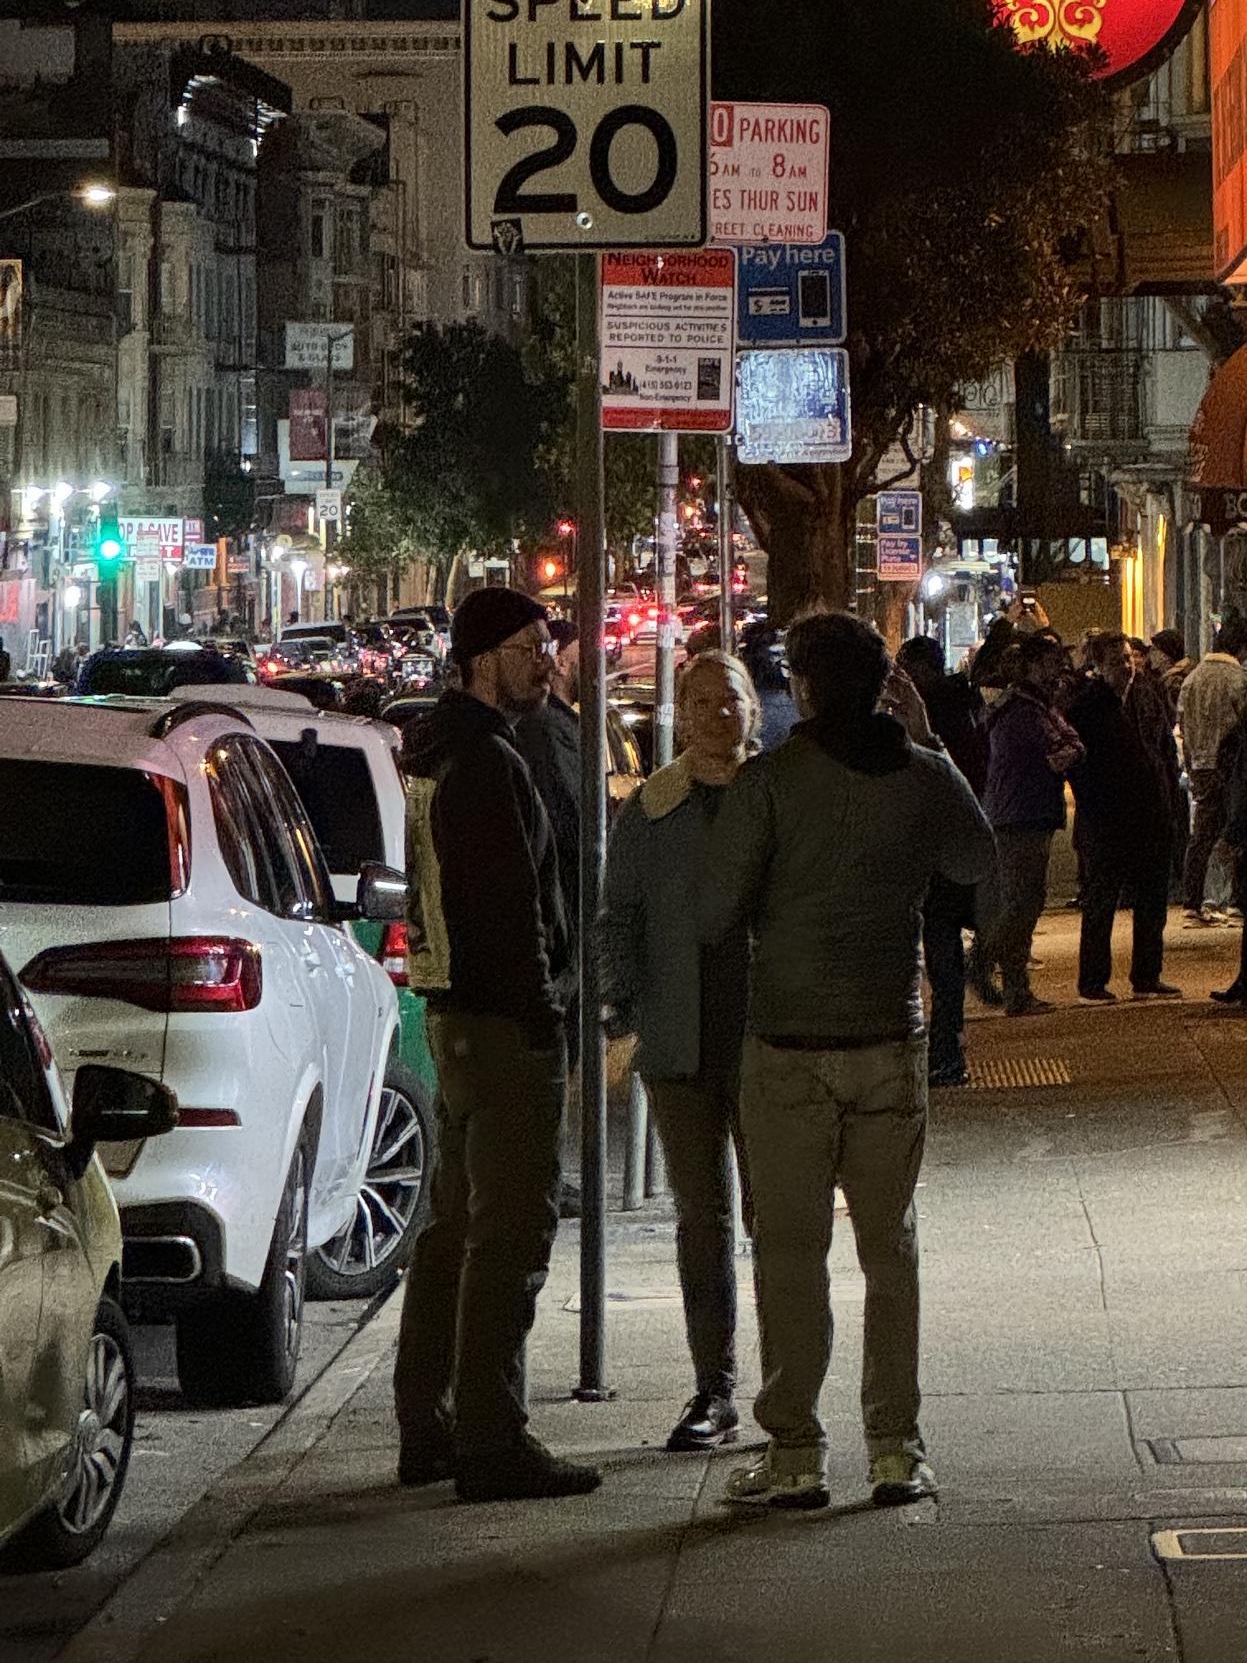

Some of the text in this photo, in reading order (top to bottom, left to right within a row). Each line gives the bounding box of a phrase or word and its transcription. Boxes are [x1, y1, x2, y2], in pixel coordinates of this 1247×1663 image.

[507, 41, 661, 86] LIMIT
[712, 108, 820, 145] O PARKING
[493, 104, 678, 214] 20
[713, 189, 818, 212] ES THUR SUN
[715, 222, 813, 237] REET CLEANING
[742, 245, 836, 270] Pay here
[660, 292, 693, 302] Program
[607, 322, 727, 332] SUSPICIOUS ACTIVITIES
[609, 333, 724, 344] REPORTED TO POLICE
[320, 505, 337, 516] 20
[189, 557, 213, 567] ATM
